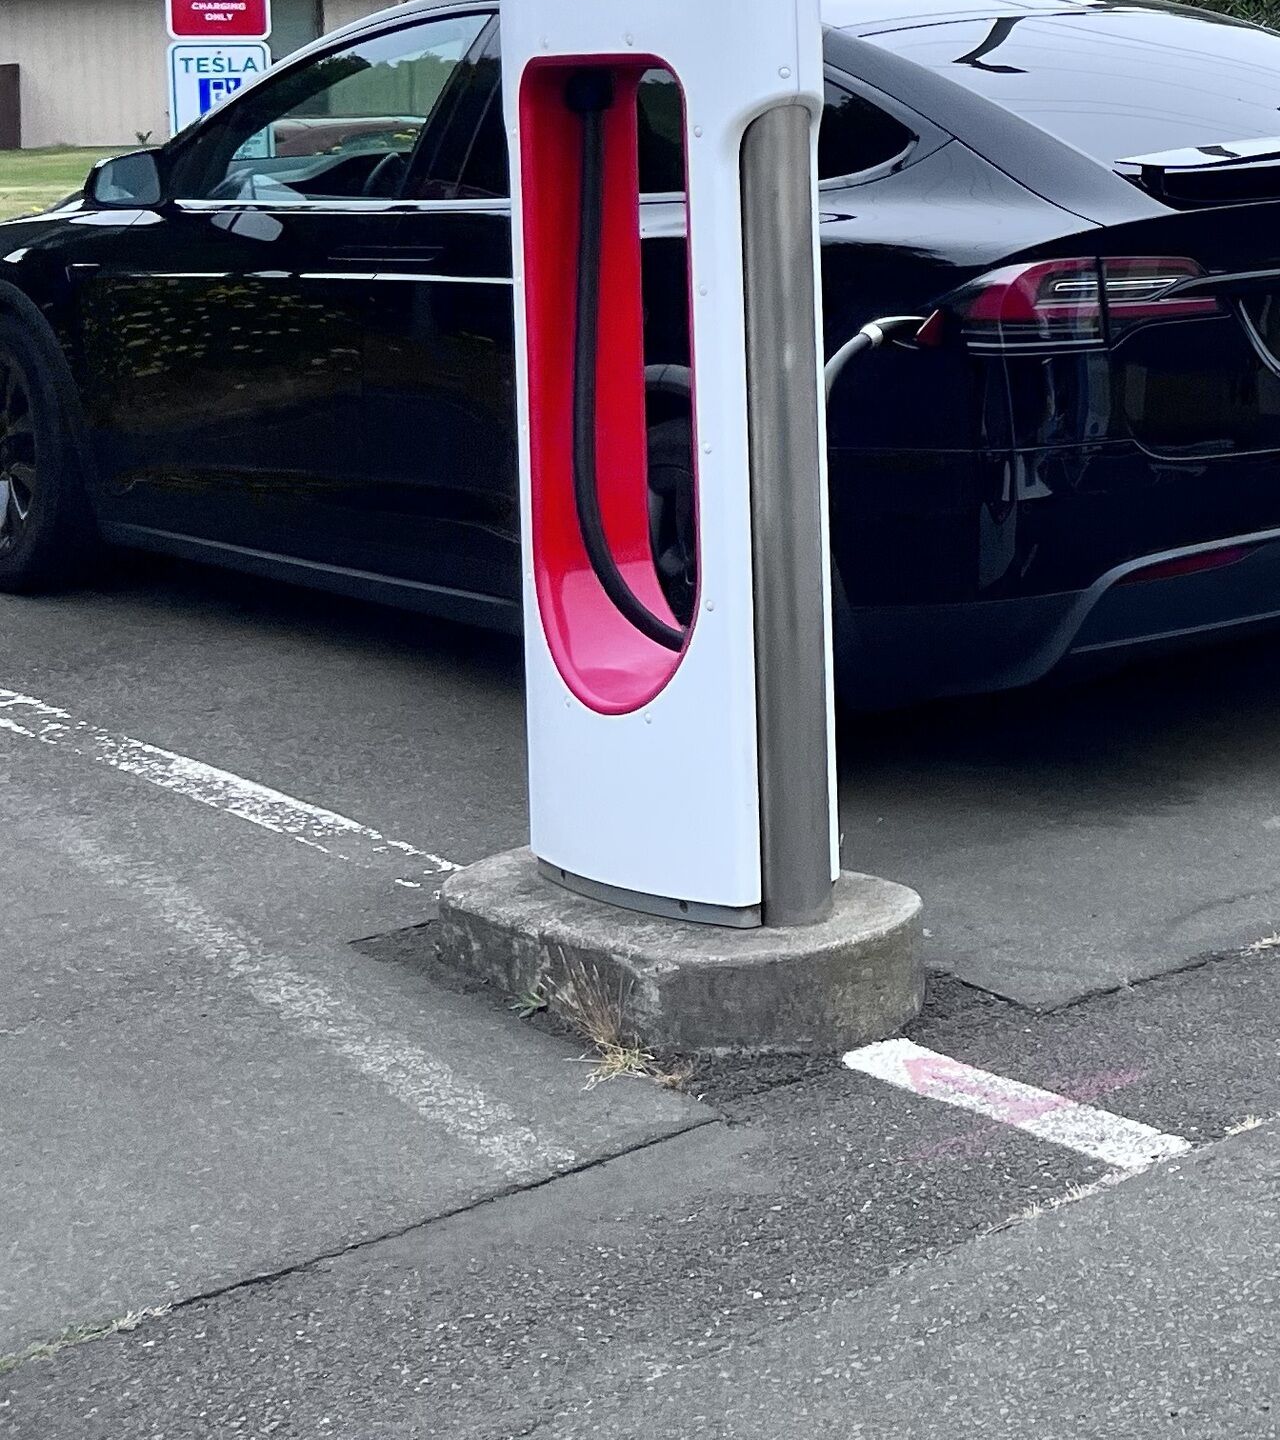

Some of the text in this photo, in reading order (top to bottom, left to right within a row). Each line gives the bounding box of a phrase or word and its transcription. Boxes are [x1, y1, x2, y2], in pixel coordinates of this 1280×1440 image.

[191, 2, 246, 10] CHARGING
[204, 13, 234, 21] ONLY
[180, 56, 258, 73] TESLA
